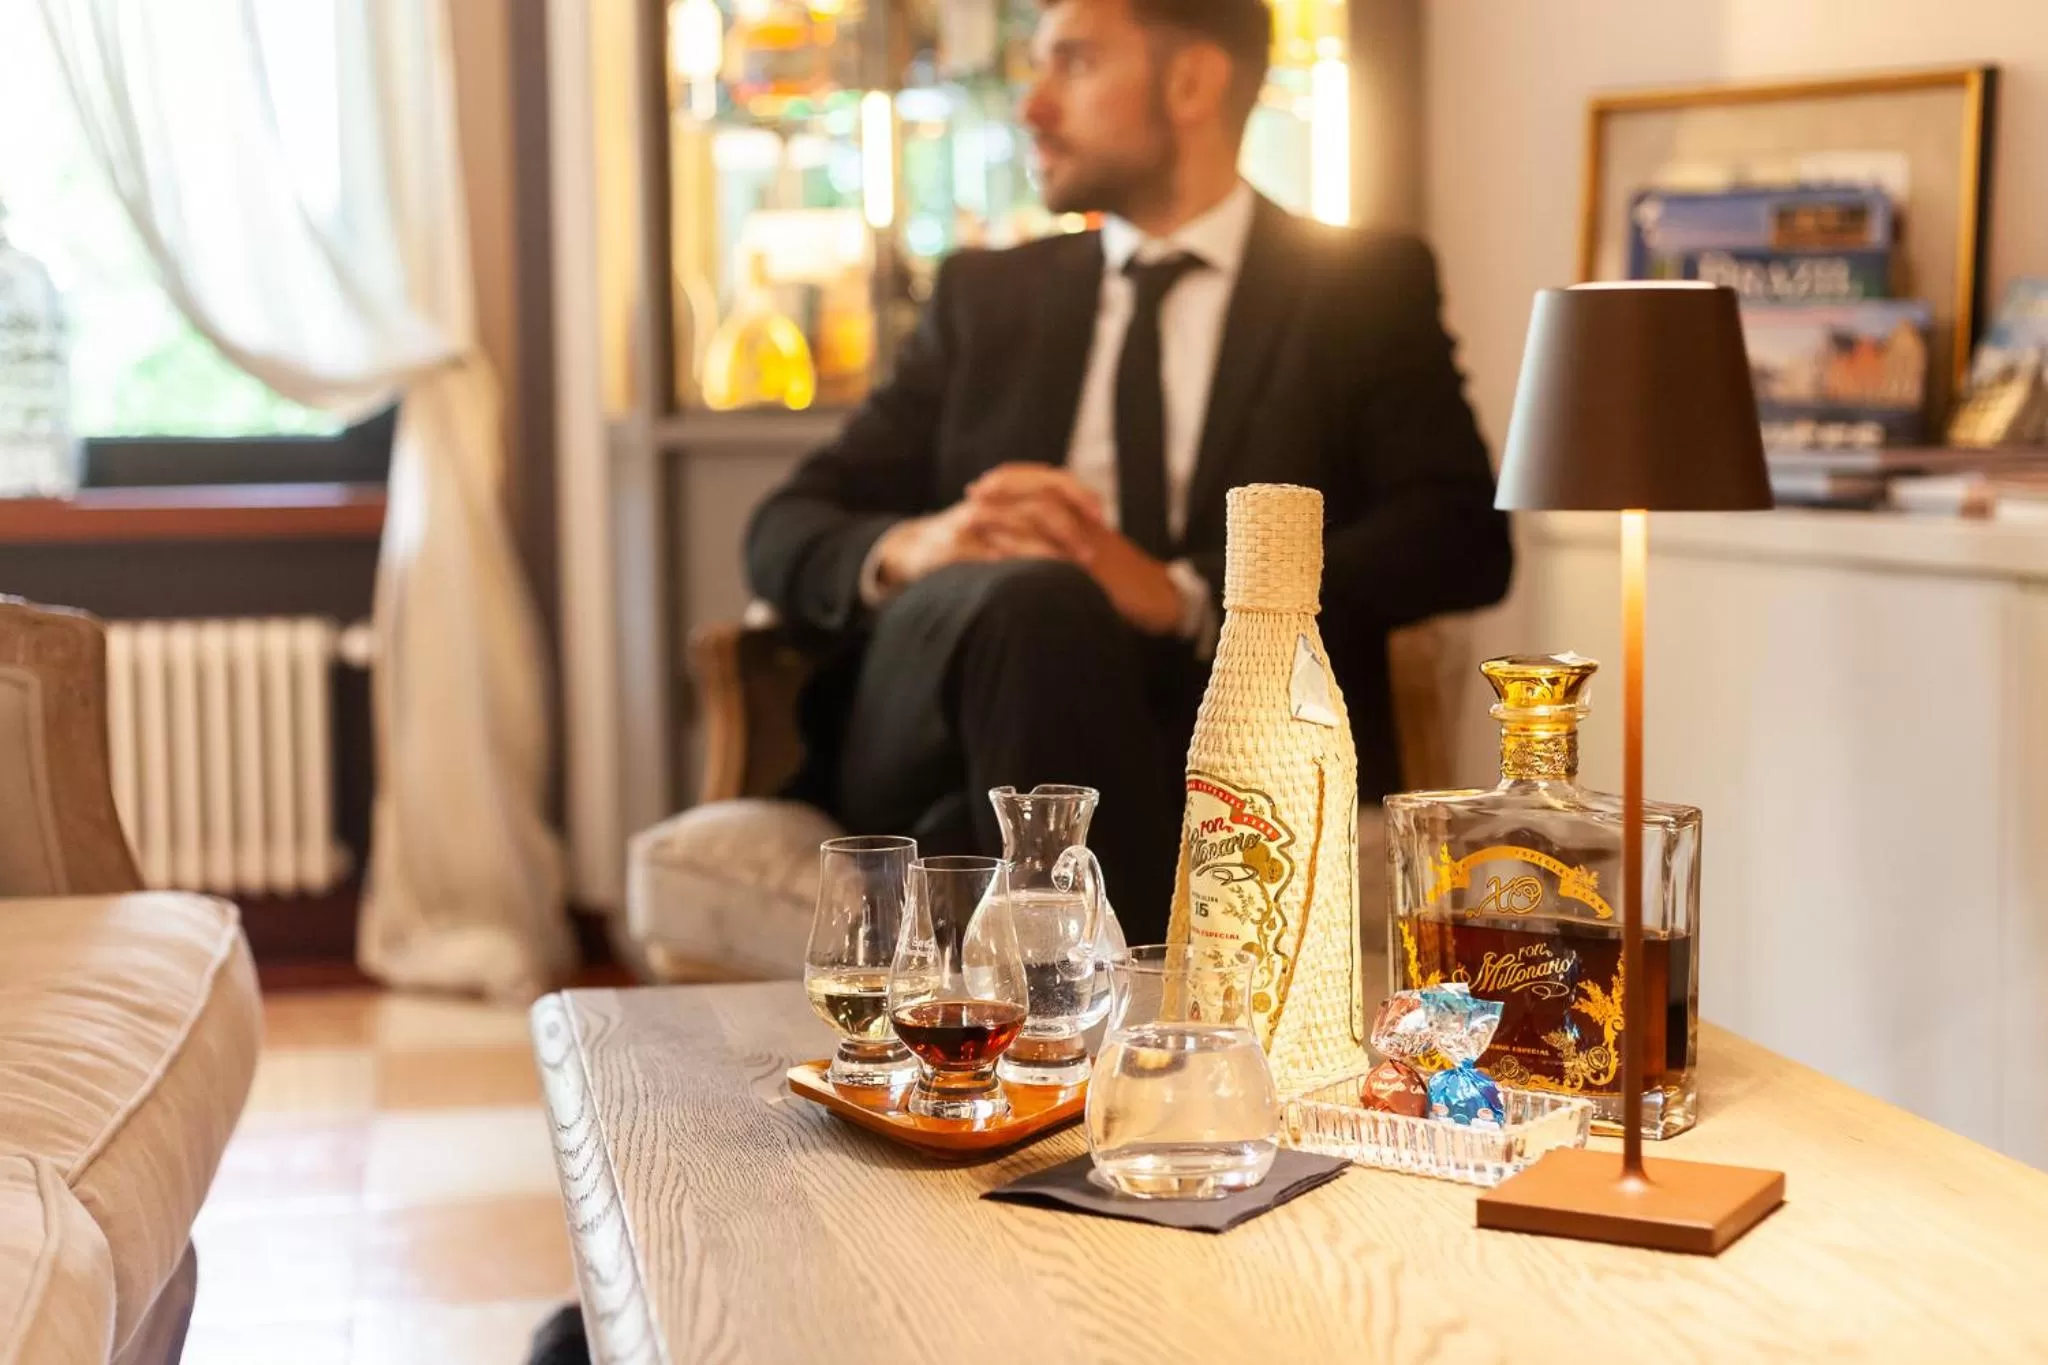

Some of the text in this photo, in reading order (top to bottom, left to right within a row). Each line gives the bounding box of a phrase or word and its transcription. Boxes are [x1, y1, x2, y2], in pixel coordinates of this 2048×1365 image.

[1464, 875, 1543, 920] XO
[1468, 949, 1577, 993] Millonario
[1517, 942, 1553, 961] ron
